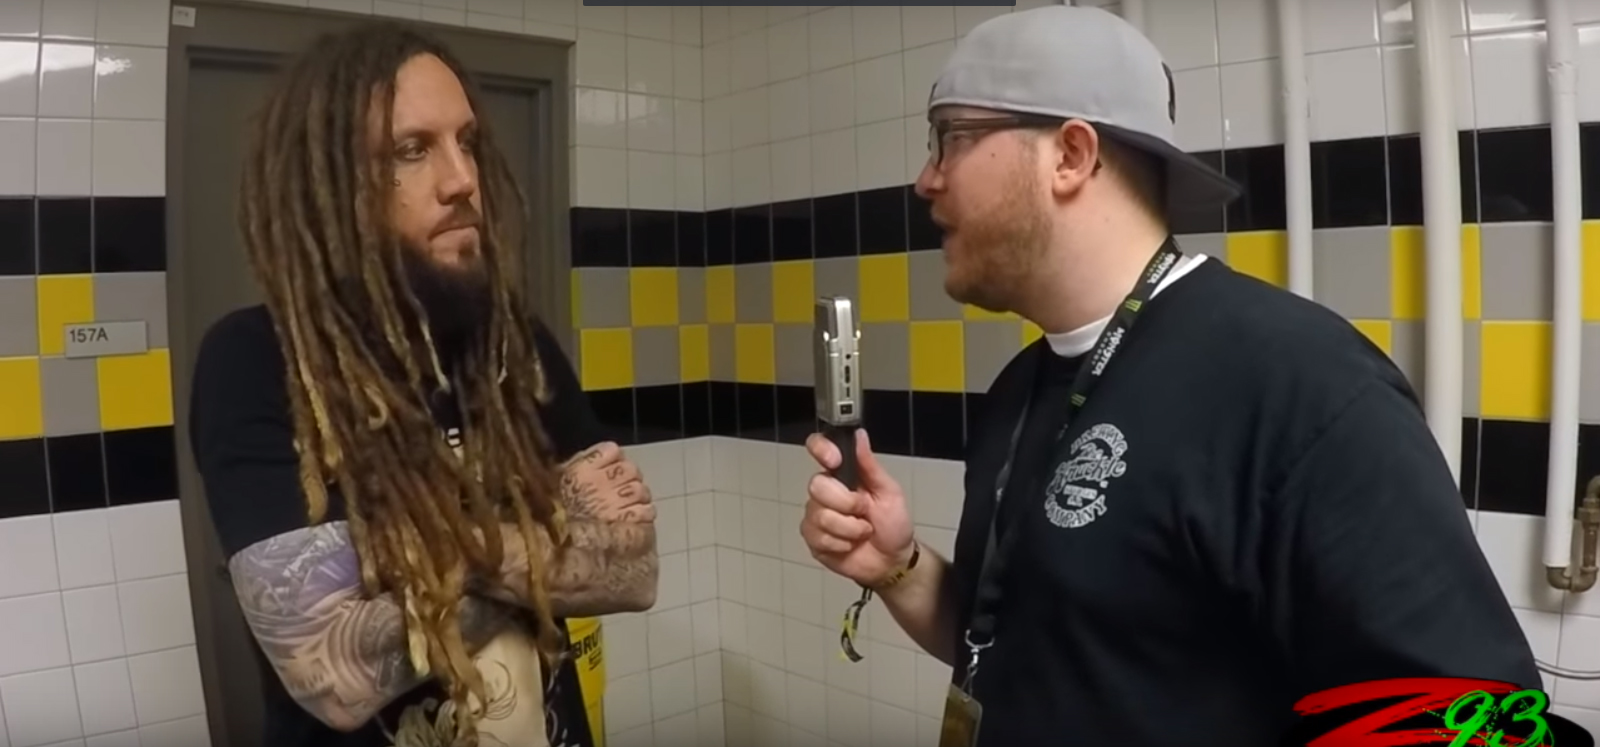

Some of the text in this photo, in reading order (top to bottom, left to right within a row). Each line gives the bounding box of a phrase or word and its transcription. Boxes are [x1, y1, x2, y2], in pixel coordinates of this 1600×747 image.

[69, 326, 109, 343] 157A
[1091, 326, 1126, 377] MONSTER
[1044, 493, 1108, 528] COMPANY
